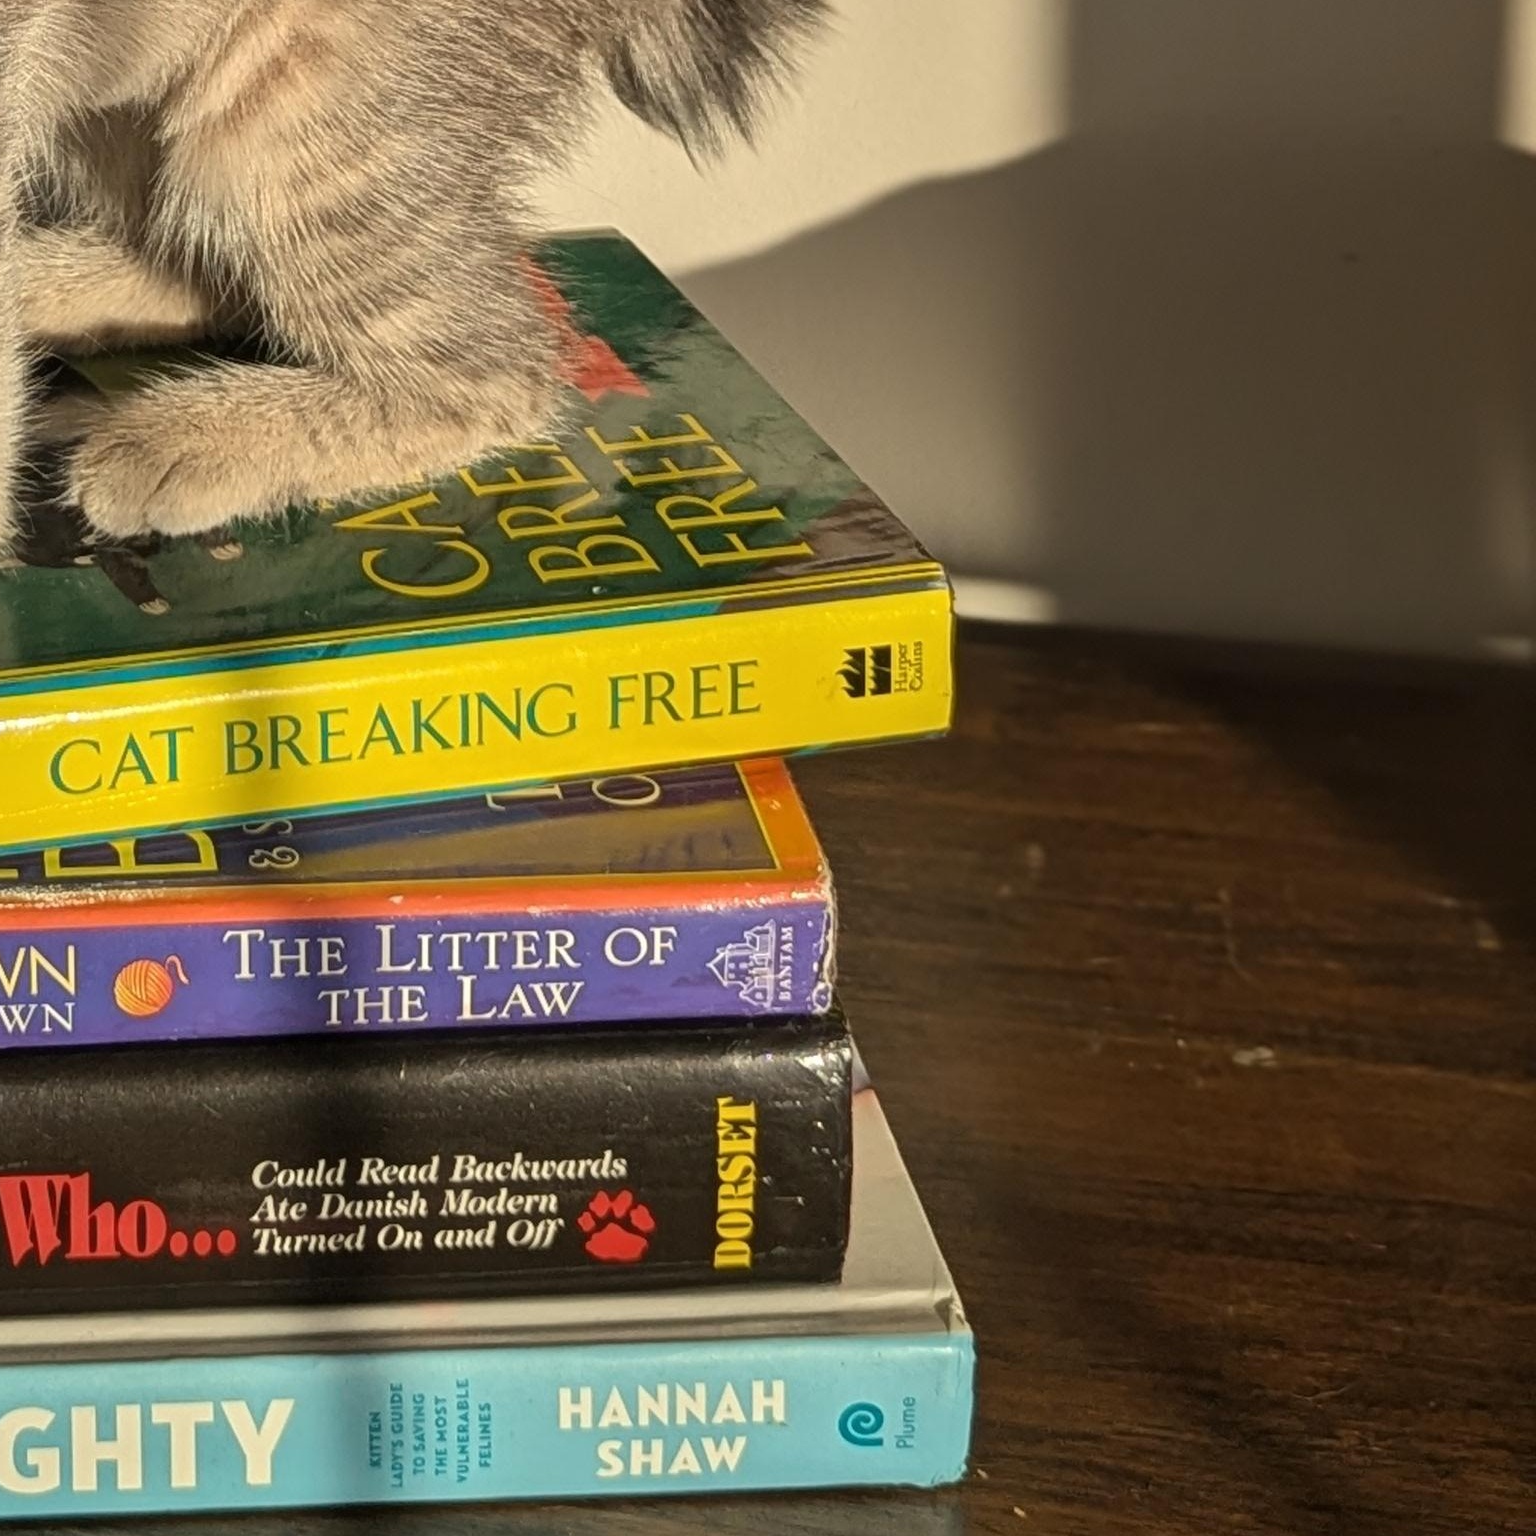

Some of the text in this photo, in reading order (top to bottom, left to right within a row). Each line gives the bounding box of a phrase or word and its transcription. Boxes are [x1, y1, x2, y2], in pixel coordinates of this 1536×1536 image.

[585, 412, 814, 568] FREE
[326, 482, 490, 599] CA
[50, 659, 762, 795] CAT BREAKING FREE
[222, 924, 678, 981] THE LITTER OF
[778, 925, 794, 1001] BANTAM
[317, 974, 585, 1026] THE LAW
[251, 1149, 628, 1190] Could Read Backwards
[713, 1096, 757, 1270] DORSET
[249, 1186, 560, 1223] Ate Danish Modern
[250, 1217, 565, 1256] Turned On and Off
[390, 1382, 404, 1488] LADY'S GUIDE
[413, 1392, 426, 1476] TO SAVING
[434, 1395, 448, 1476] THE MOST
[456, 1378, 470, 1484] VULNERABLE
[478, 1402, 492, 1469] FELINES
[558, 1379, 786, 1430] HANNAH
[896, 1396, 917, 1449] Plume
[369, 1411, 382, 1469] KITTEN
[595, 1435, 748, 1478] SHAW
